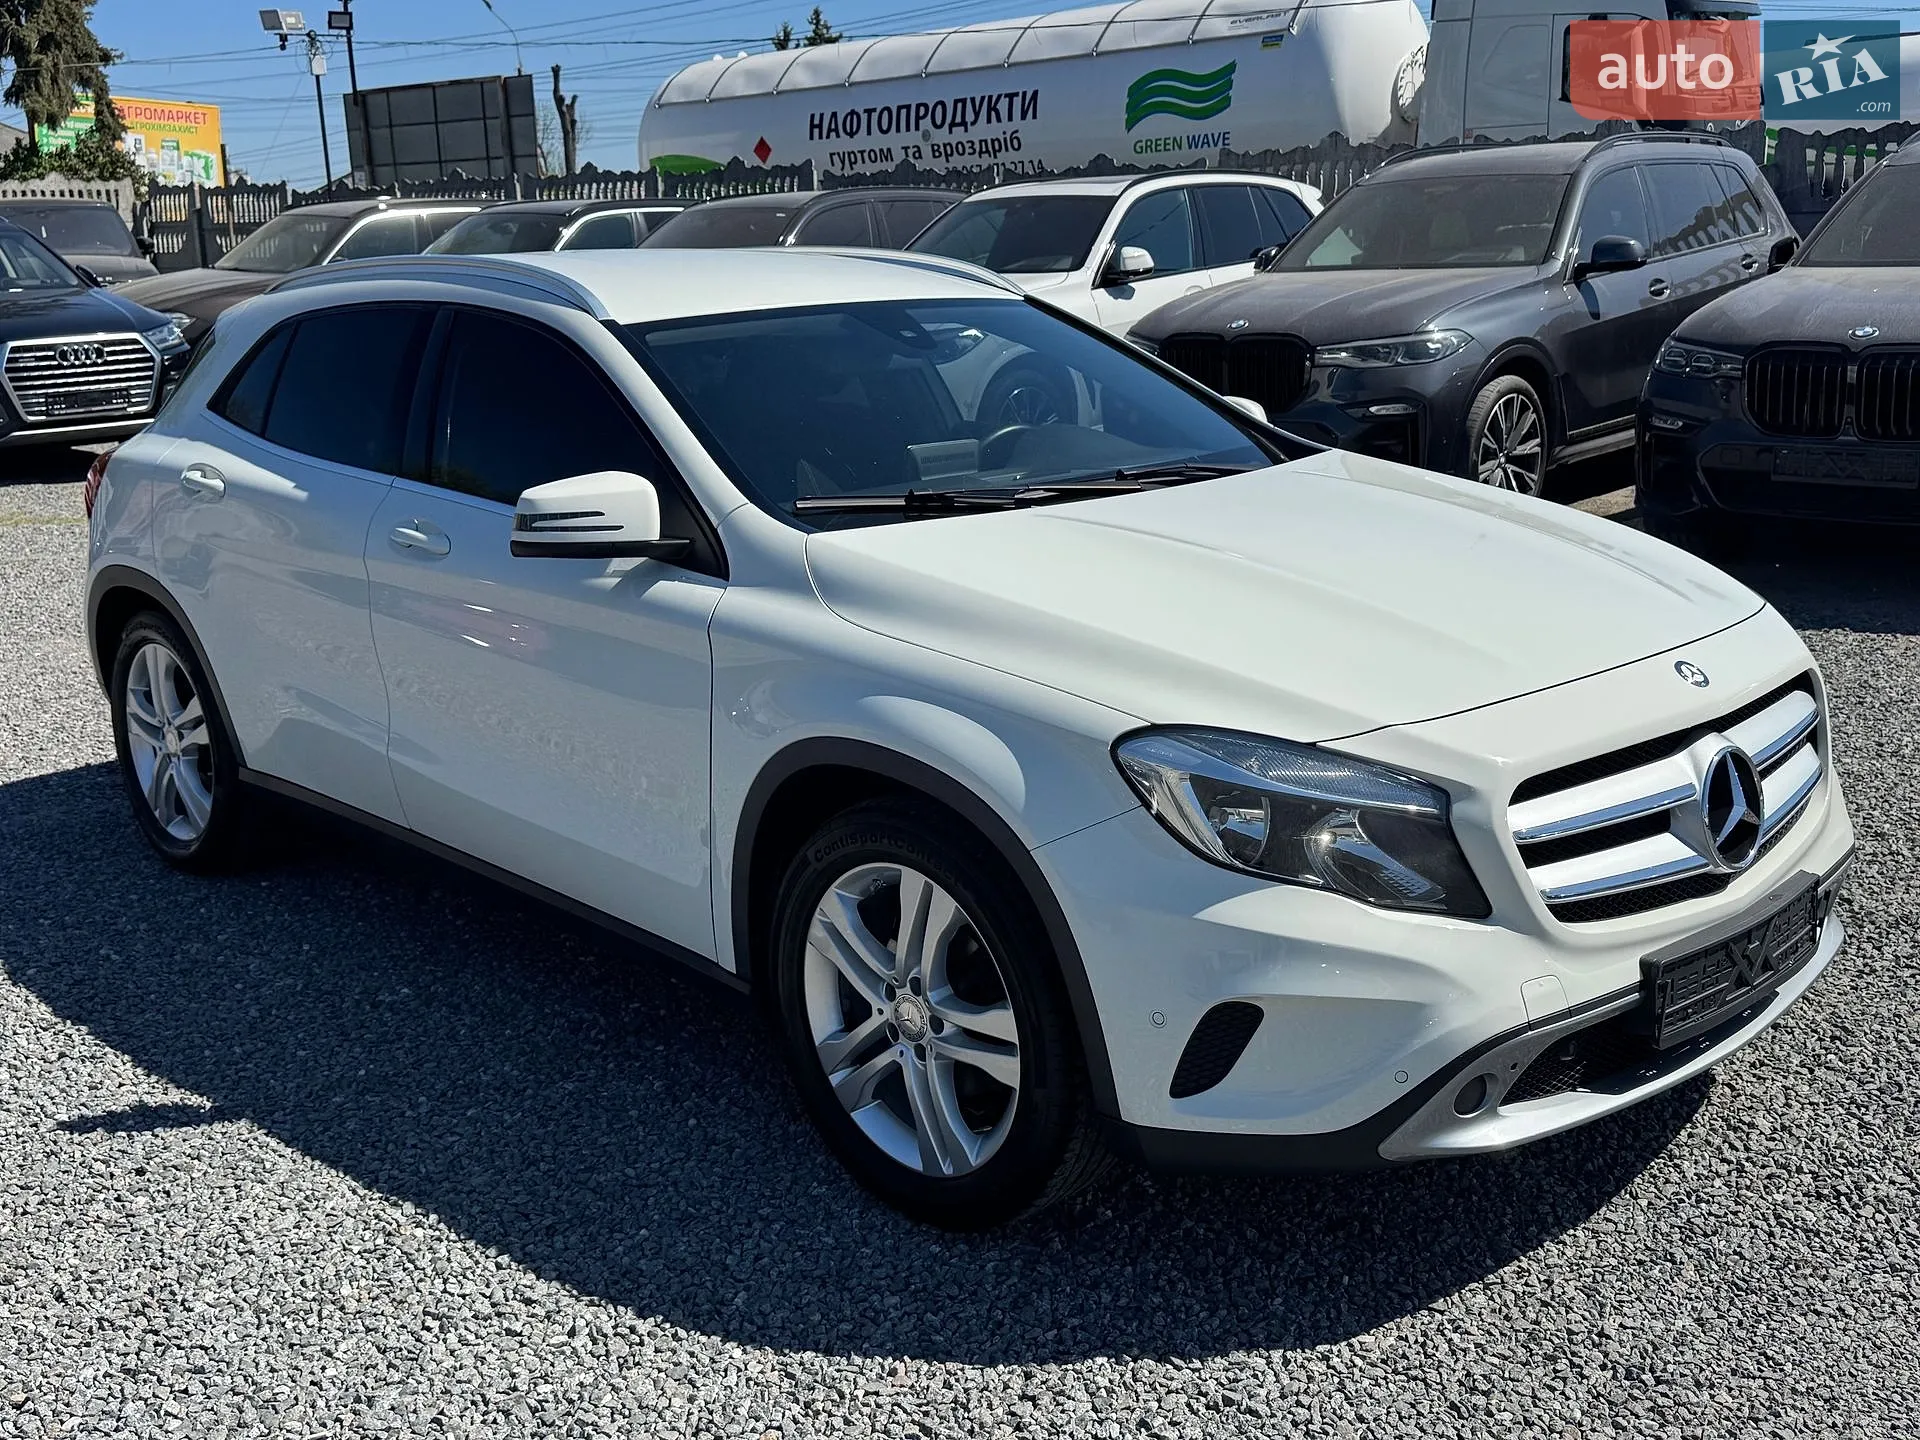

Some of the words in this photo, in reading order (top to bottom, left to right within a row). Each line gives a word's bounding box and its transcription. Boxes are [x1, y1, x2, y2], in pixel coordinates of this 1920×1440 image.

[808, 89, 1039, 141] НАФТОПРОДУКТИ
[829, 147, 895, 172] гуртом
[901, 145, 923, 160] та
[930, 129, 1022, 164] вроздріб
[1133, 135, 1183, 155] GREEN
[1186, 131, 1231, 150] WAVE
